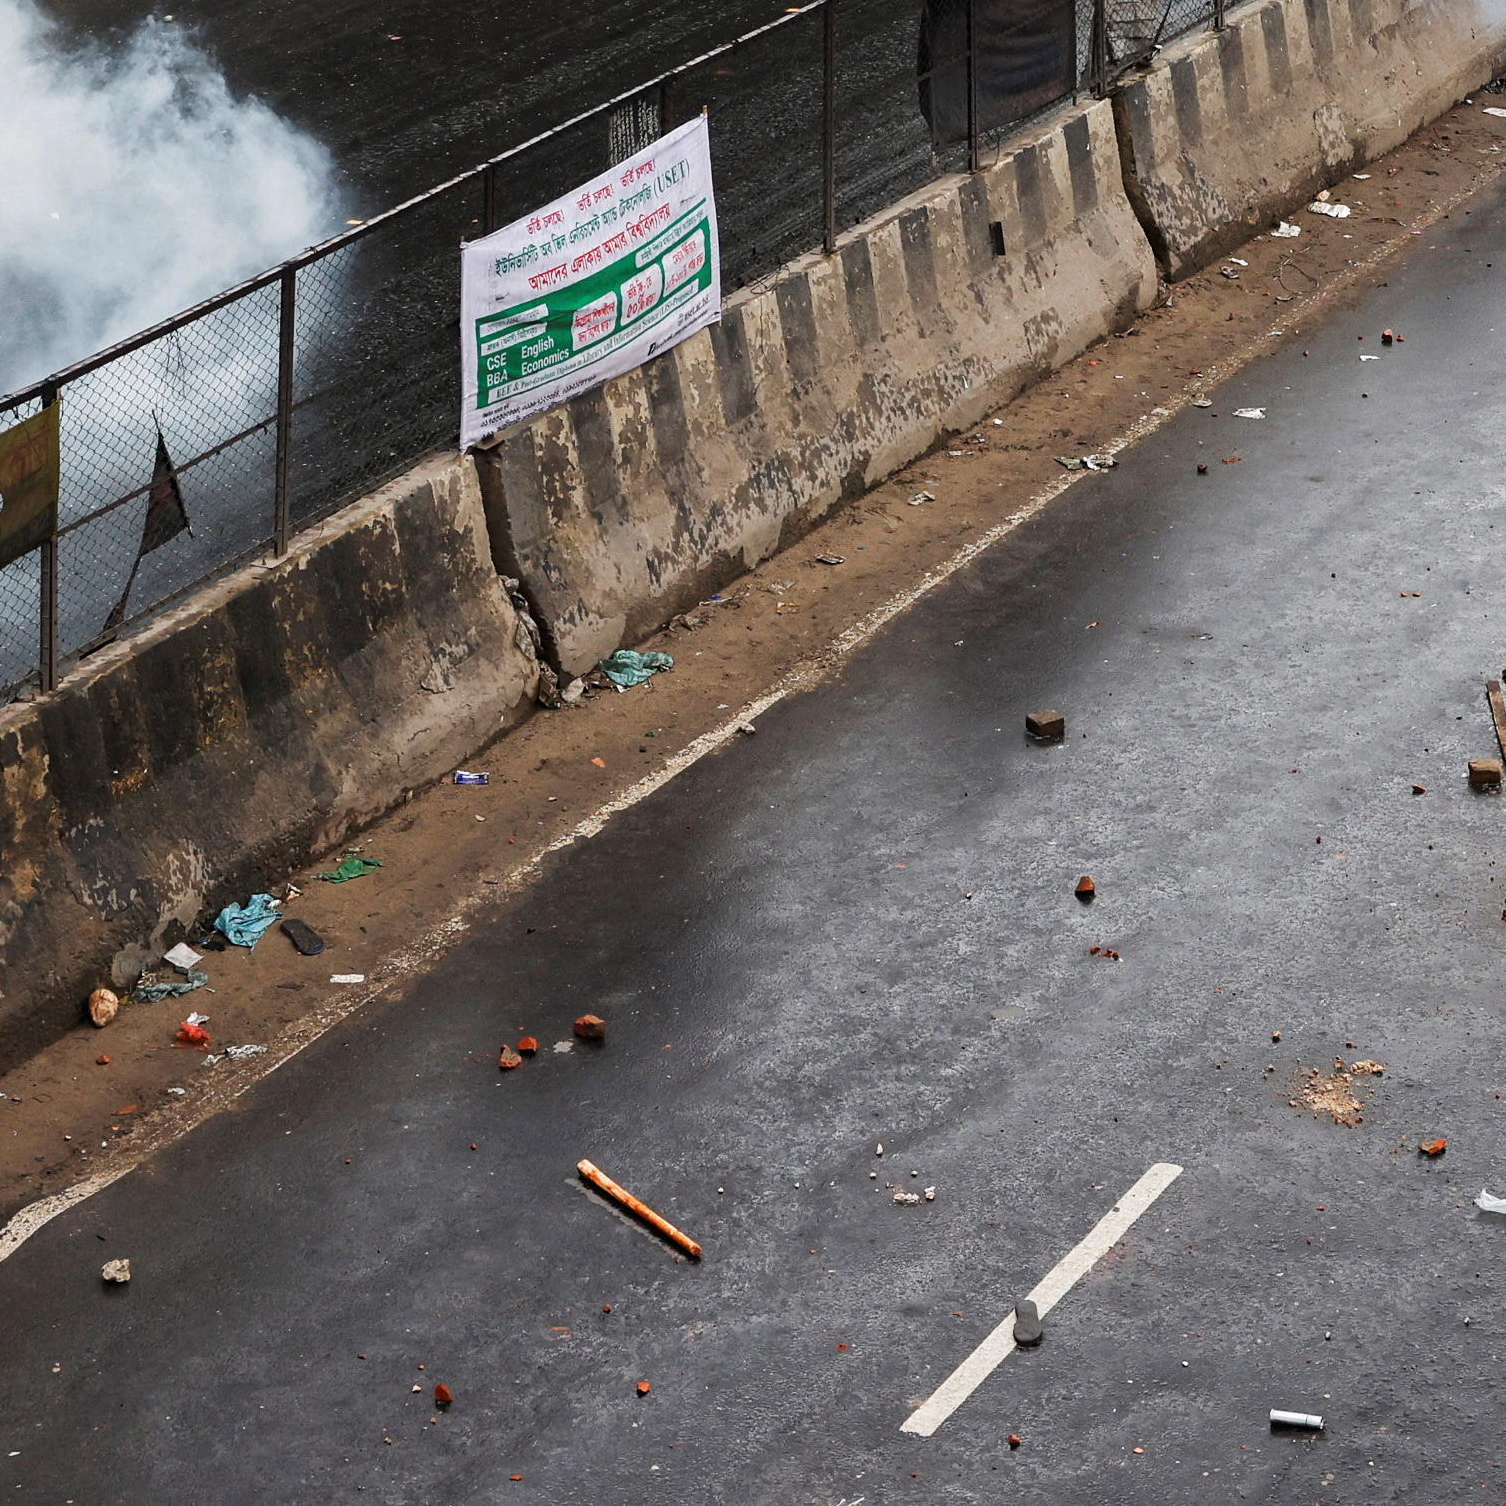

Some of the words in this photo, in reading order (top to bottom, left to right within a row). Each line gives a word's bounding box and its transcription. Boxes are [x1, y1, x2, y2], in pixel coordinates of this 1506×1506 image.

[495, 243, 539, 278] ইউনিভার্সিটি
[539, 241, 553, 258] অব
[551, 233, 568, 254] স্কিল
[653, 157, 691, 199] (USET)
[526, 214, 542, 235] ভর্তি
[576, 190, 592, 212] ভর্তি
[620, 167, 636, 187] ভর্তি
[527, 262, 569, 291] আমাদের
[571, 245, 603, 274] এলাকায়
[601, 231, 628, 257] আমার
[625, 202, 671, 244] বিশ্ববিদ্যালয়
[486, 352, 507, 371] CSE
[521, 335, 555, 360] English
[486, 369, 508, 387] BBA
[521, 348, 570, 376] Economics
[496, 384, 513, 399] EEE
[513, 382, 520, 392] &
[582, 349, 603, 364] Library
[603, 341, 613, 353] and
